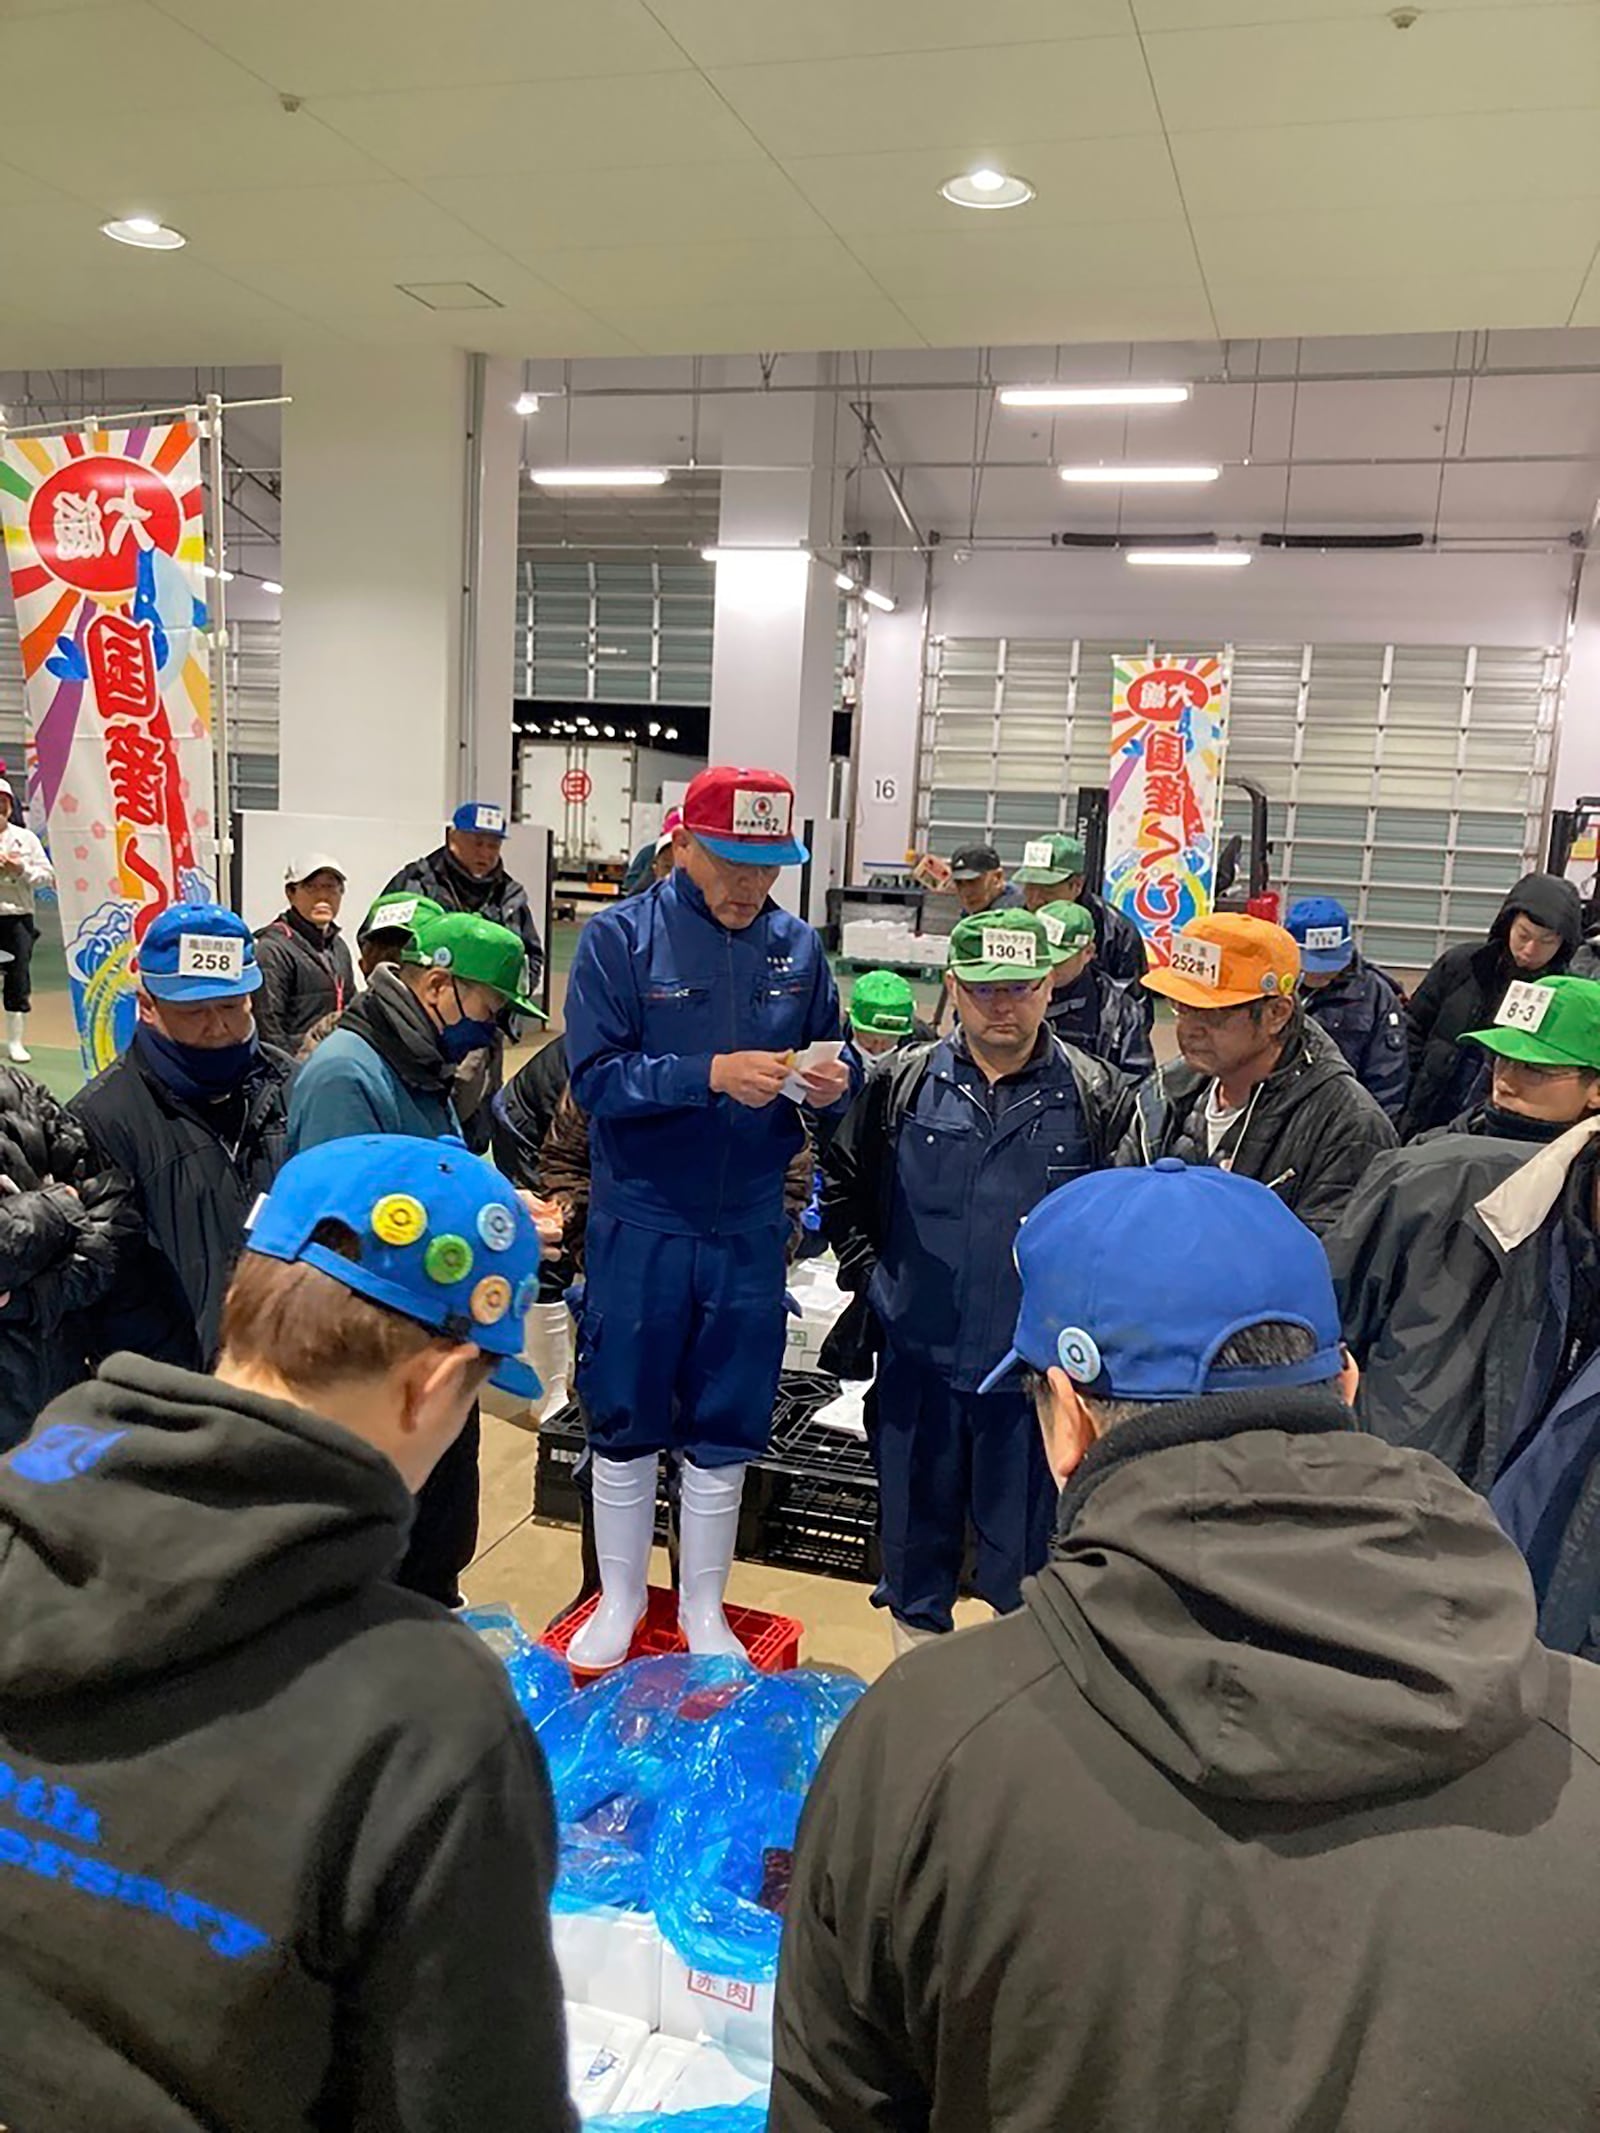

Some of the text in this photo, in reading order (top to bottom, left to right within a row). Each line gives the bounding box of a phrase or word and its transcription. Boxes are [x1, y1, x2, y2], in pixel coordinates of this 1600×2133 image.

[876, 779, 895, 799] 16
[987, 943, 1032, 961] 130-1
[192, 953, 230, 971] 258
